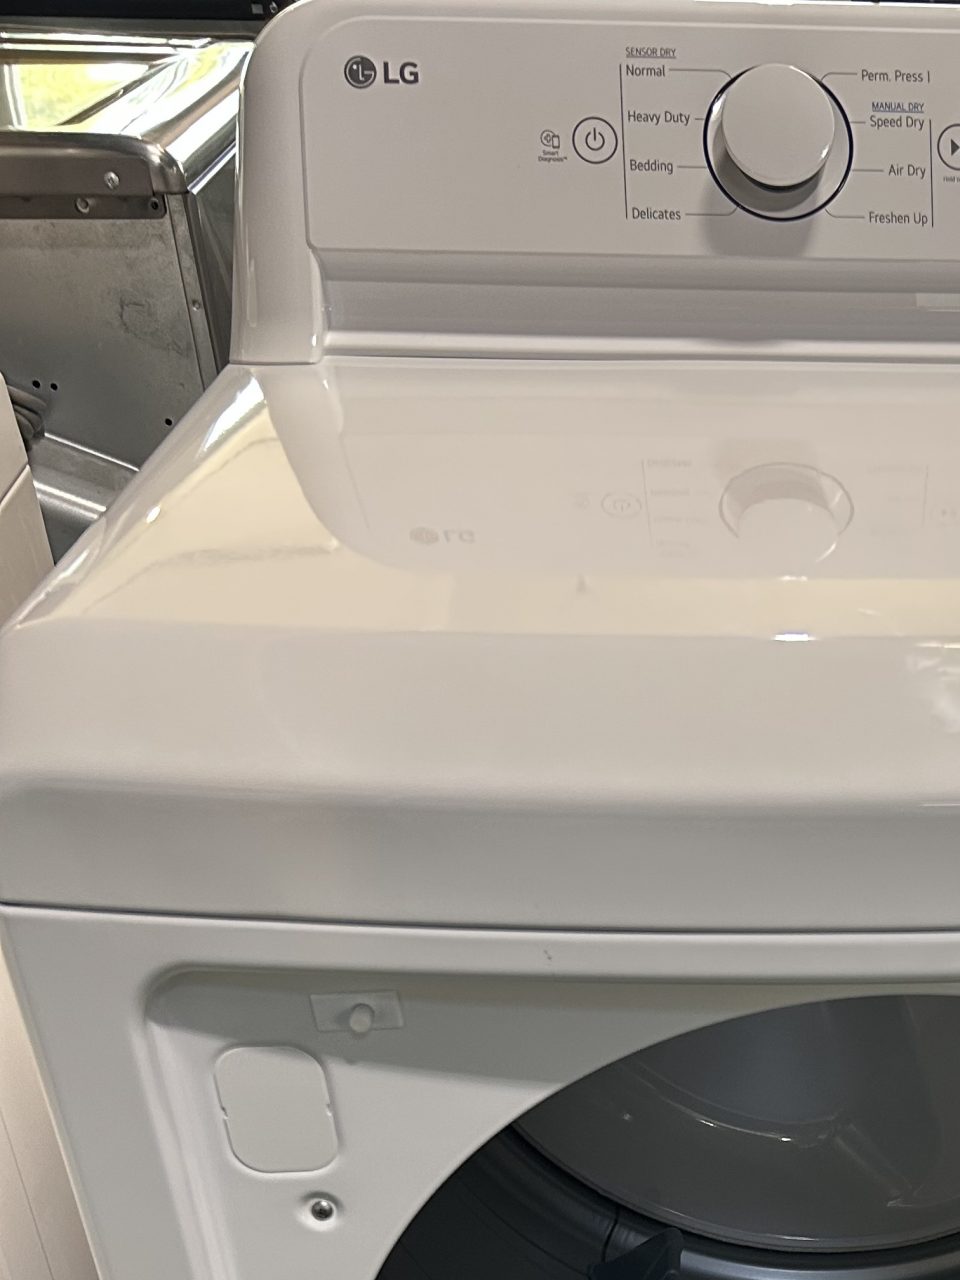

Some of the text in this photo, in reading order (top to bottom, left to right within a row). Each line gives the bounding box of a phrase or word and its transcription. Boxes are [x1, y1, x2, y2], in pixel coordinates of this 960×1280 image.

[625, 47, 676, 58] SENSOR DRY
[383, 61, 419, 84] LG
[626, 65, 666, 78] Normal
[861, 70, 924, 83] Perm. Press
[871, 102, 924, 113] MANUAL DRY
[627, 111, 691, 125] Heavy Duty
[869, 115, 925, 131] Speed Dry
[630, 160, 673, 174] Bedding
[888, 164, 926, 180] Air Dry
[631, 207, 681, 220] Delicates
[868, 211, 928, 226] Freshen Up
